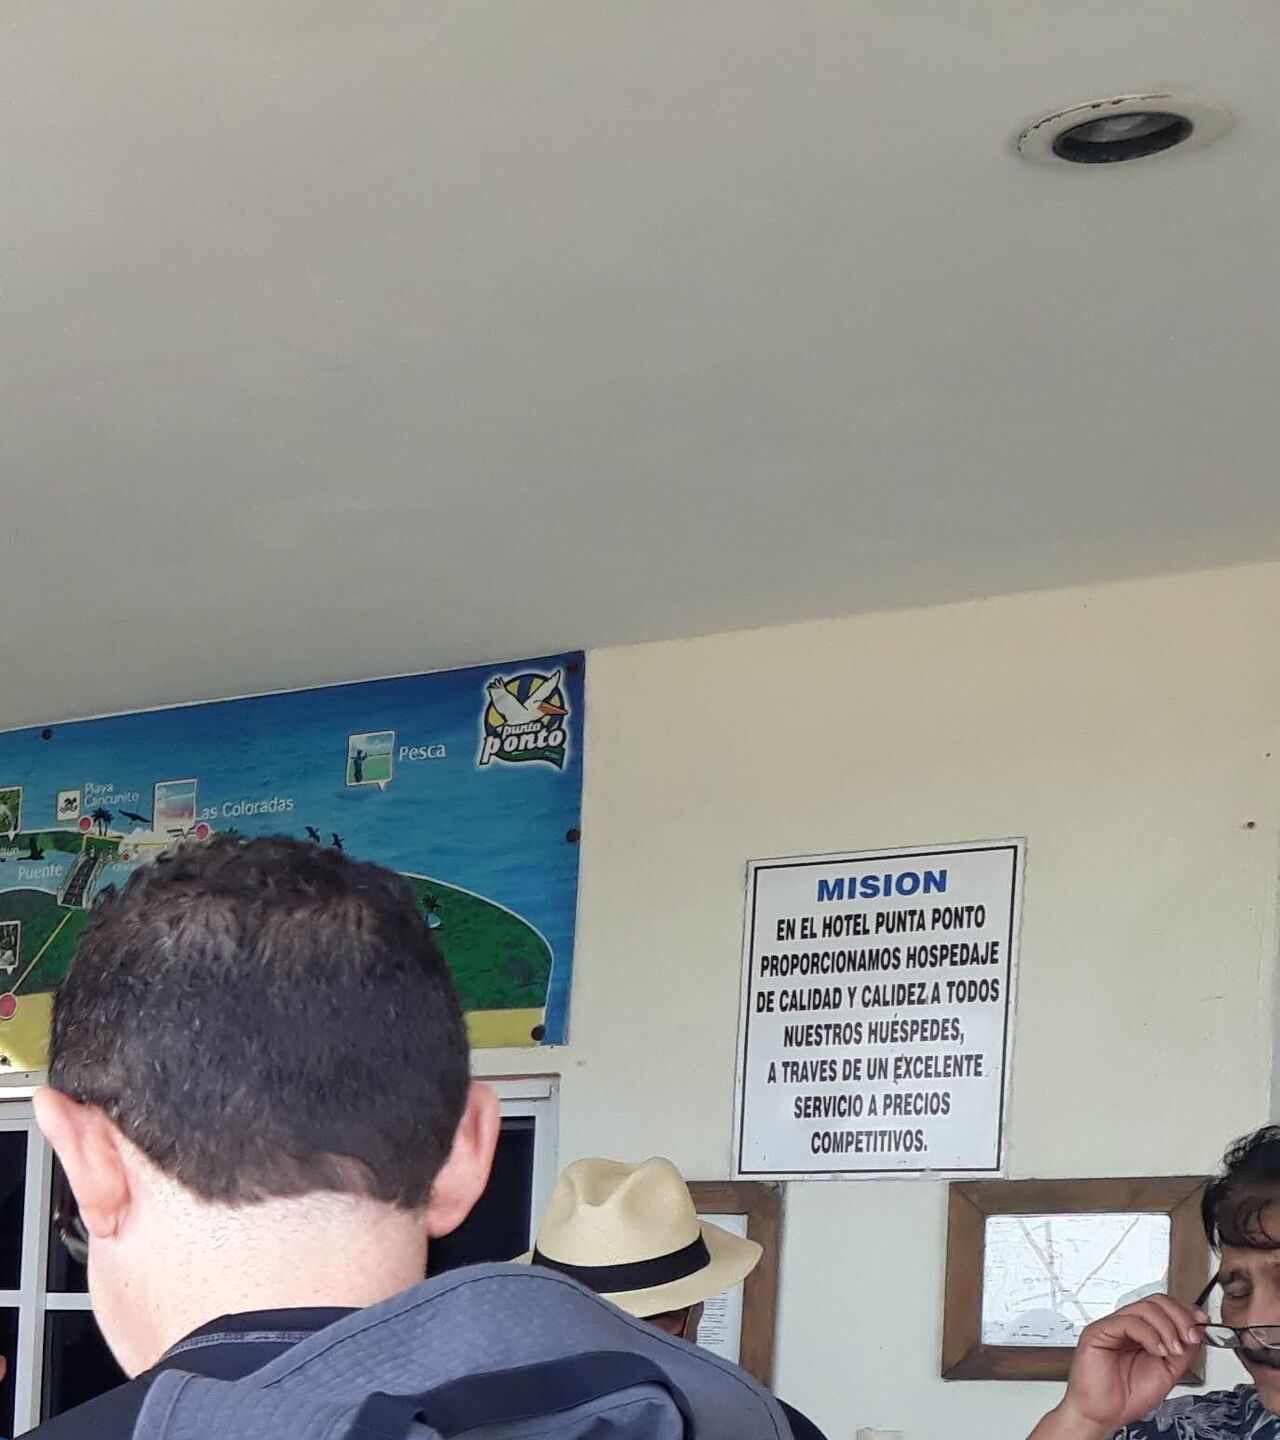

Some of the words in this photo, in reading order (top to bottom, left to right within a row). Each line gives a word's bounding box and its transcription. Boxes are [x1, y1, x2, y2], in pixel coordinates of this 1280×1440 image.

[502, 722, 542, 736] punta
[399, 743, 446, 761] Pesca
[480, 727, 564, 764] ponto
[84, 782, 114, 796] Playa
[221, 796, 294, 819] Coloradas
[18, 864, 63, 881] Puente
[817, 869, 948, 902] MISION
[777, 919, 796, 941] EN
[800, 918, 818, 939] EL
[822, 913, 870, 938] HOTEL
[874, 909, 927, 934] PUNTA
[931, 905, 986, 931] PONTO
[761, 947, 901, 978] PROPORCIONAMOS
[906, 941, 999, 969] HOSPEDAJE
[756, 992, 775, 1013] DE
[779, 987, 842, 1011] CALIDAD
[847, 986, 858, 1009] Y
[861, 982, 928, 1008] CALIDEZ
[929, 982, 941, 1005] A
[946, 979, 1000, 1003] TODOS
[783, 1023, 862, 1047] NUESTROS
[867, 1013, 965, 1045] HUÉSPEDES,
[767, 1063, 777, 1084] A
[782, 1059, 837, 1083] TRAVES
[842, 1058, 861, 1081] DE
[867, 1057, 888, 1080] UN
[894, 1054, 983, 1080] EXCELENTE
[794, 1096, 863, 1119] SERVICIO
[867, 1095, 878, 1117] A
[883, 1092, 951, 1116] PRECIOS
[811, 1130, 928, 1154] COMPETITIVOS.
